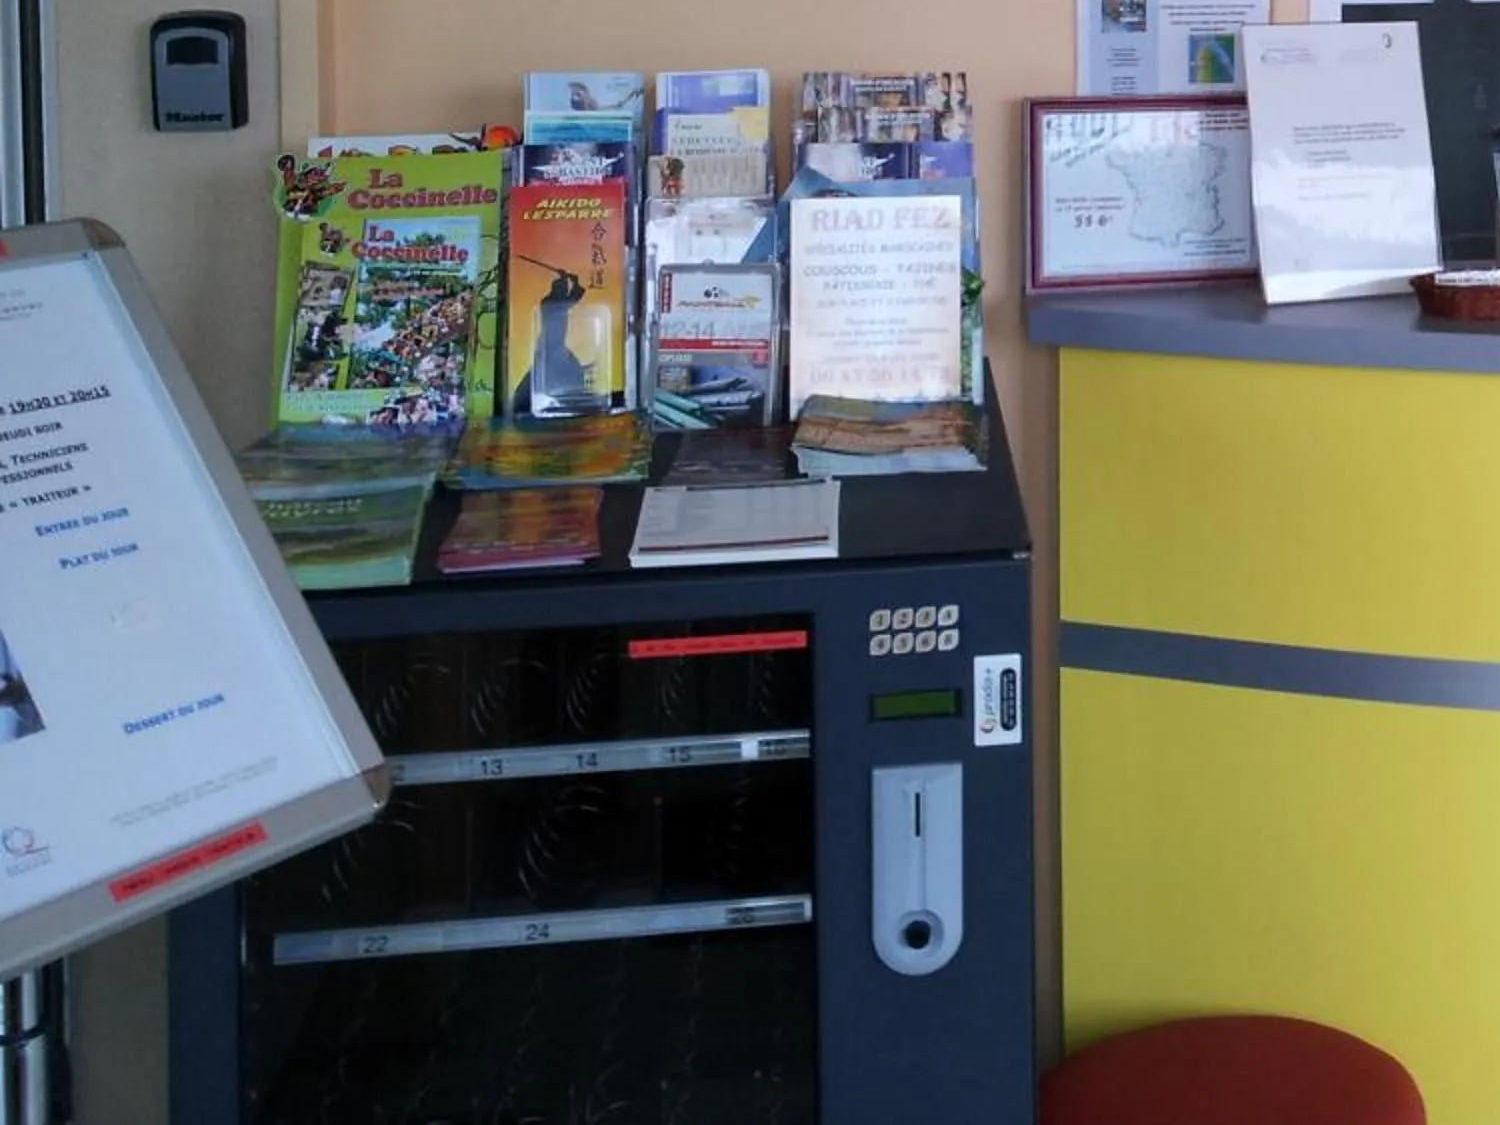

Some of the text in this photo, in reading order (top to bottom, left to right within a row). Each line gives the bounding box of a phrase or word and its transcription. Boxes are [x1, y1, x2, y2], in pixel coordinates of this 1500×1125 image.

[368, 168, 404, 189] La
[347, 185, 498, 211] Coccinelle
[536, 197, 602, 209] AIKIDO
[810, 207, 886, 232] RIAD
[368, 225, 395, 242] La
[351, 241, 469, 263] Coccinelle
[480, 759, 503, 776] 13
[575, 752, 599, 769] 14
[363, 935, 389, 954] 22
[524, 922, 550, 942] 24
